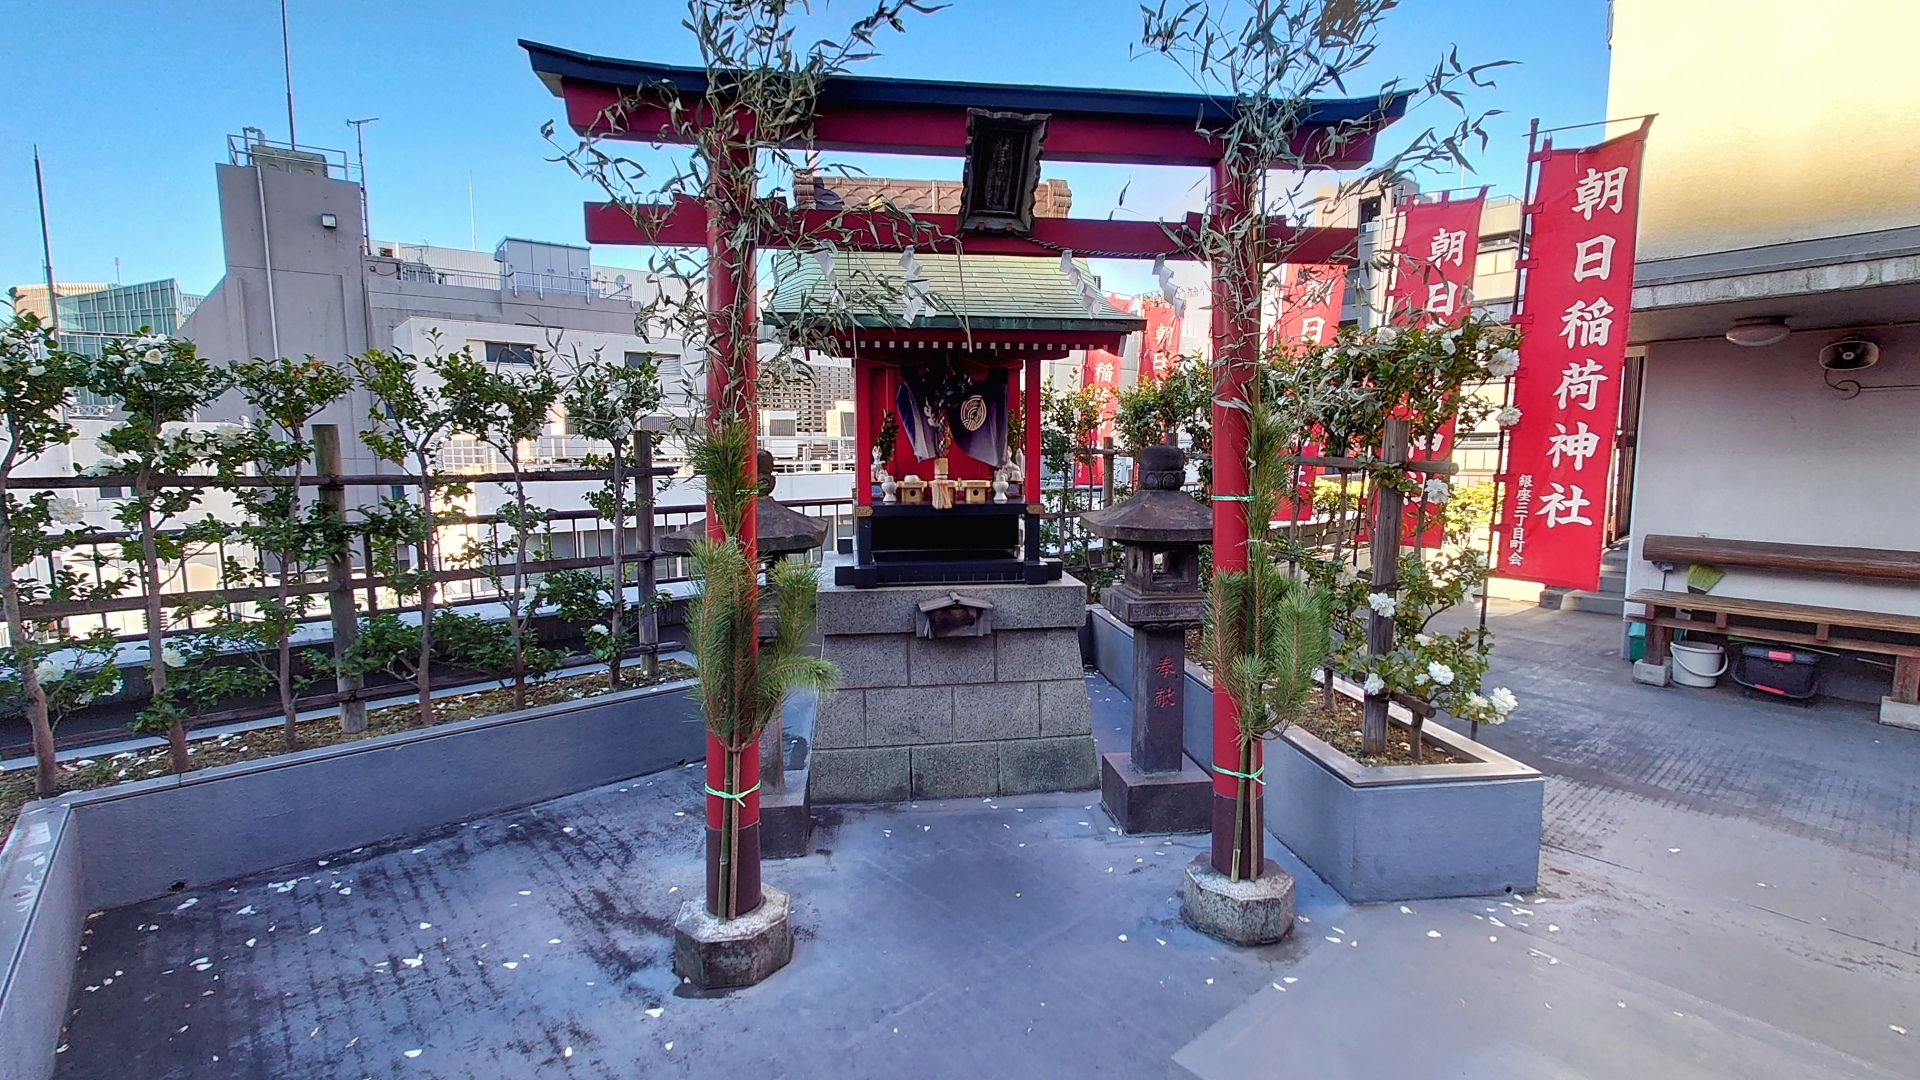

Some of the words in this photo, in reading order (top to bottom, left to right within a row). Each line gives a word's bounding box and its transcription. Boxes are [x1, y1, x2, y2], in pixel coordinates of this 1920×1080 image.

[1535, 166, 1629, 529] 朝日稲荷神社
[1508, 473, 1534, 566] 銀座三丁目町会
